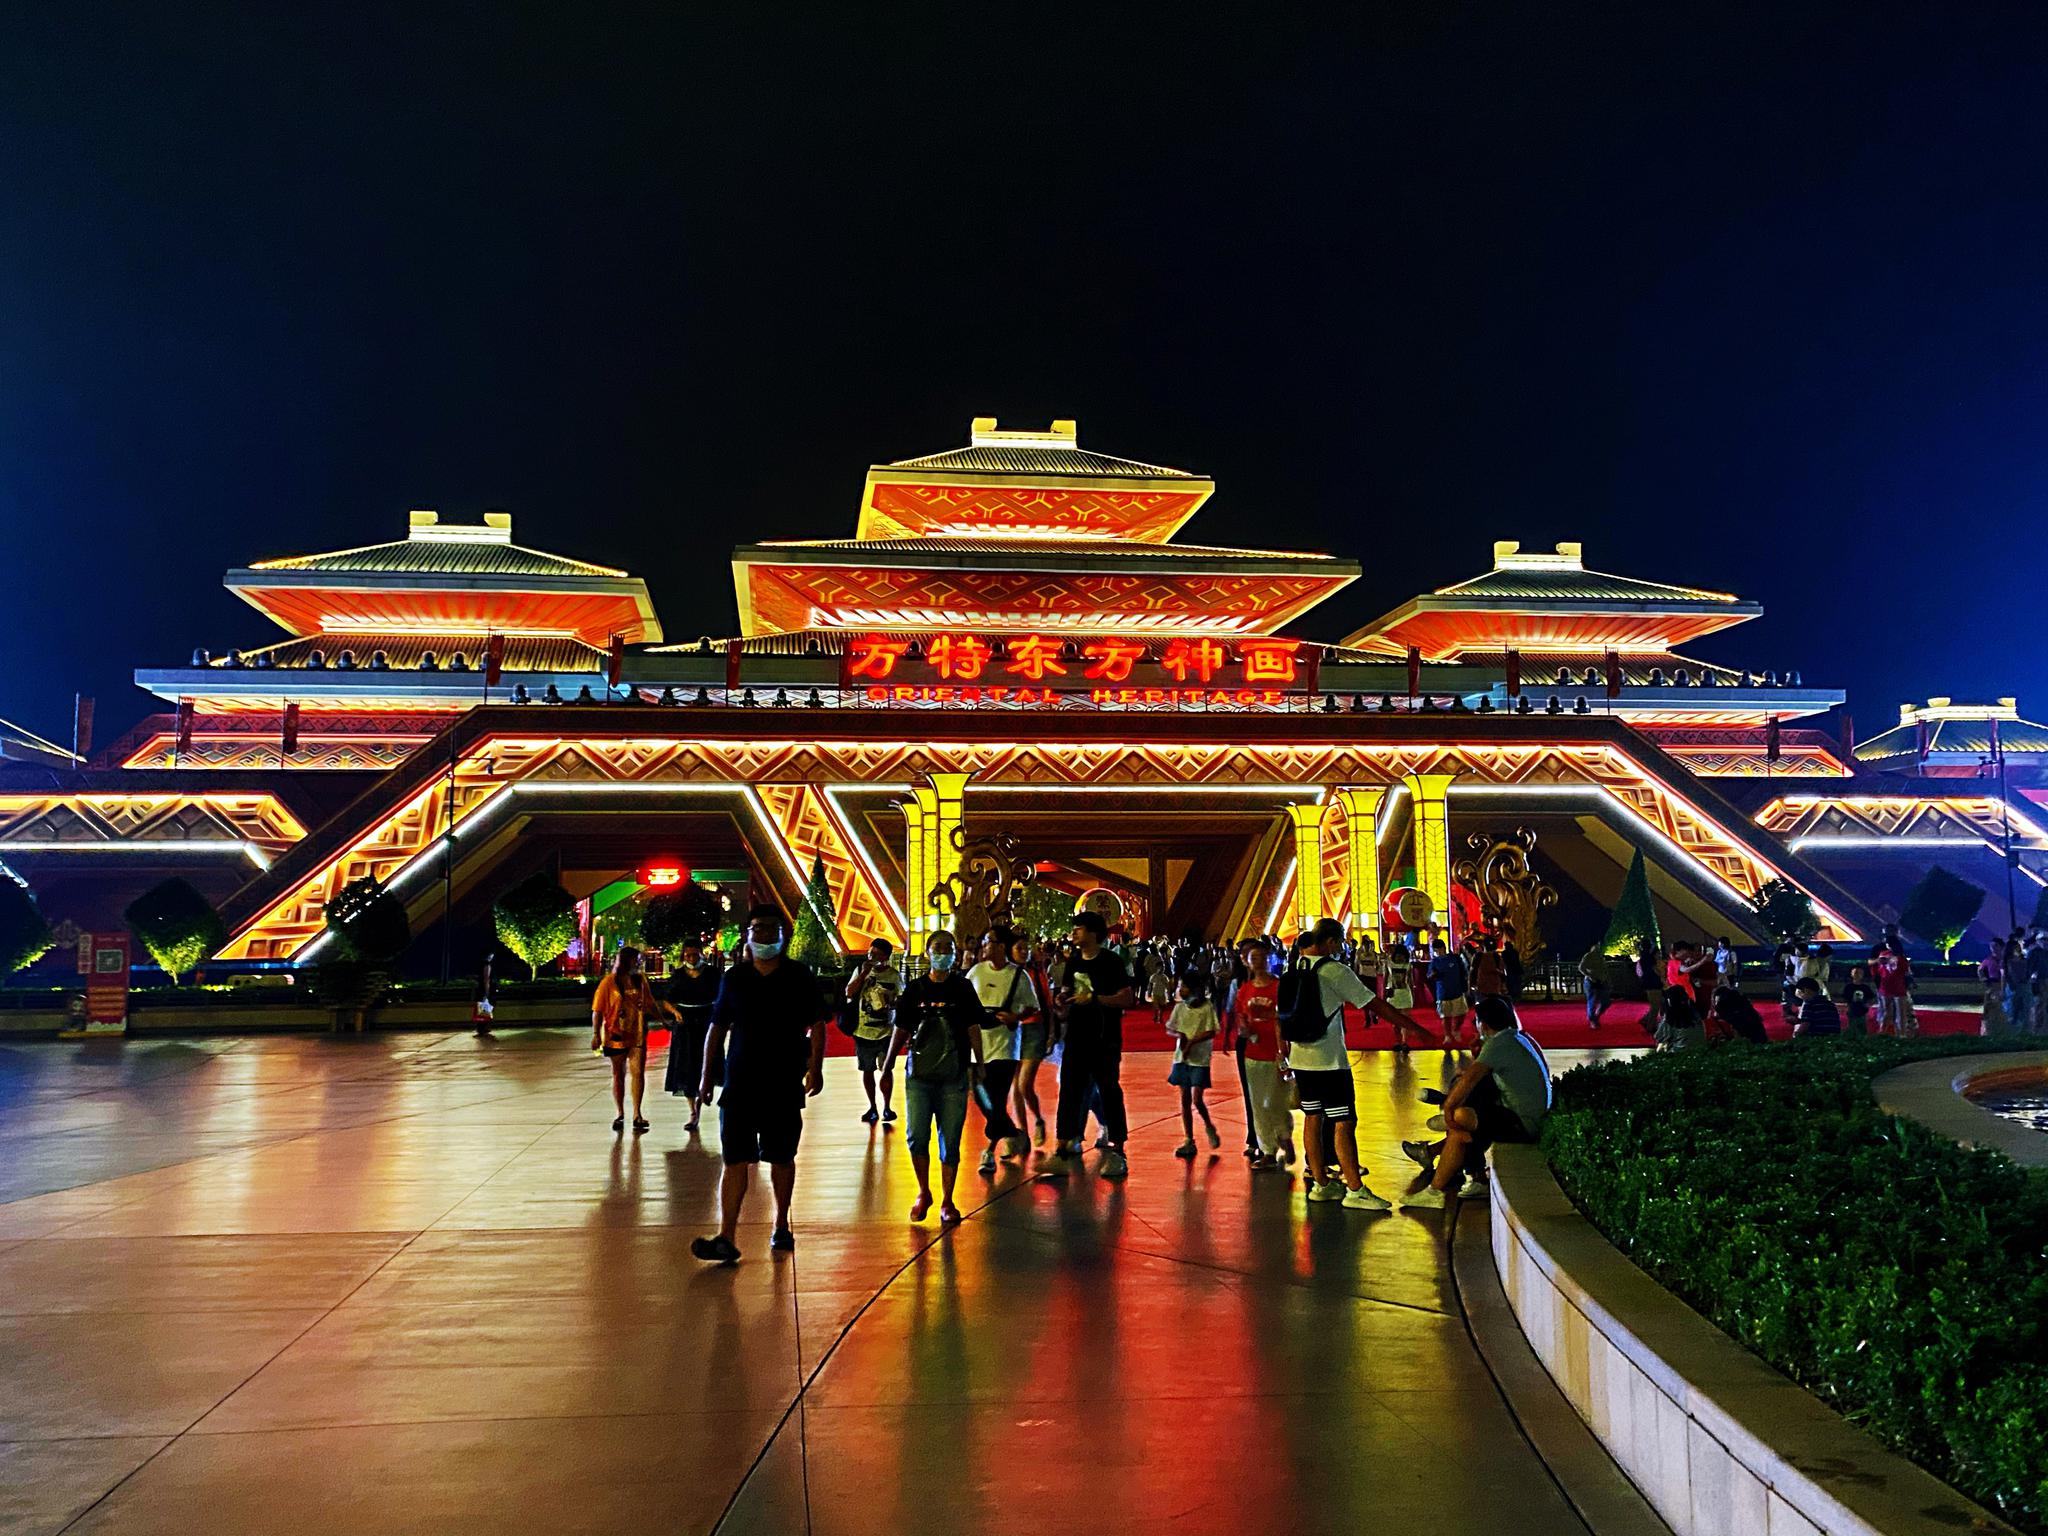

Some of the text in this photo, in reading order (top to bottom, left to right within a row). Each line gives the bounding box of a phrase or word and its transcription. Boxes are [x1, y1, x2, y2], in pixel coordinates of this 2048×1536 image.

[851, 635, 1300, 682] 方特东方神画
[868, 687, 1284, 704] ORIENTAL HERITAGE
